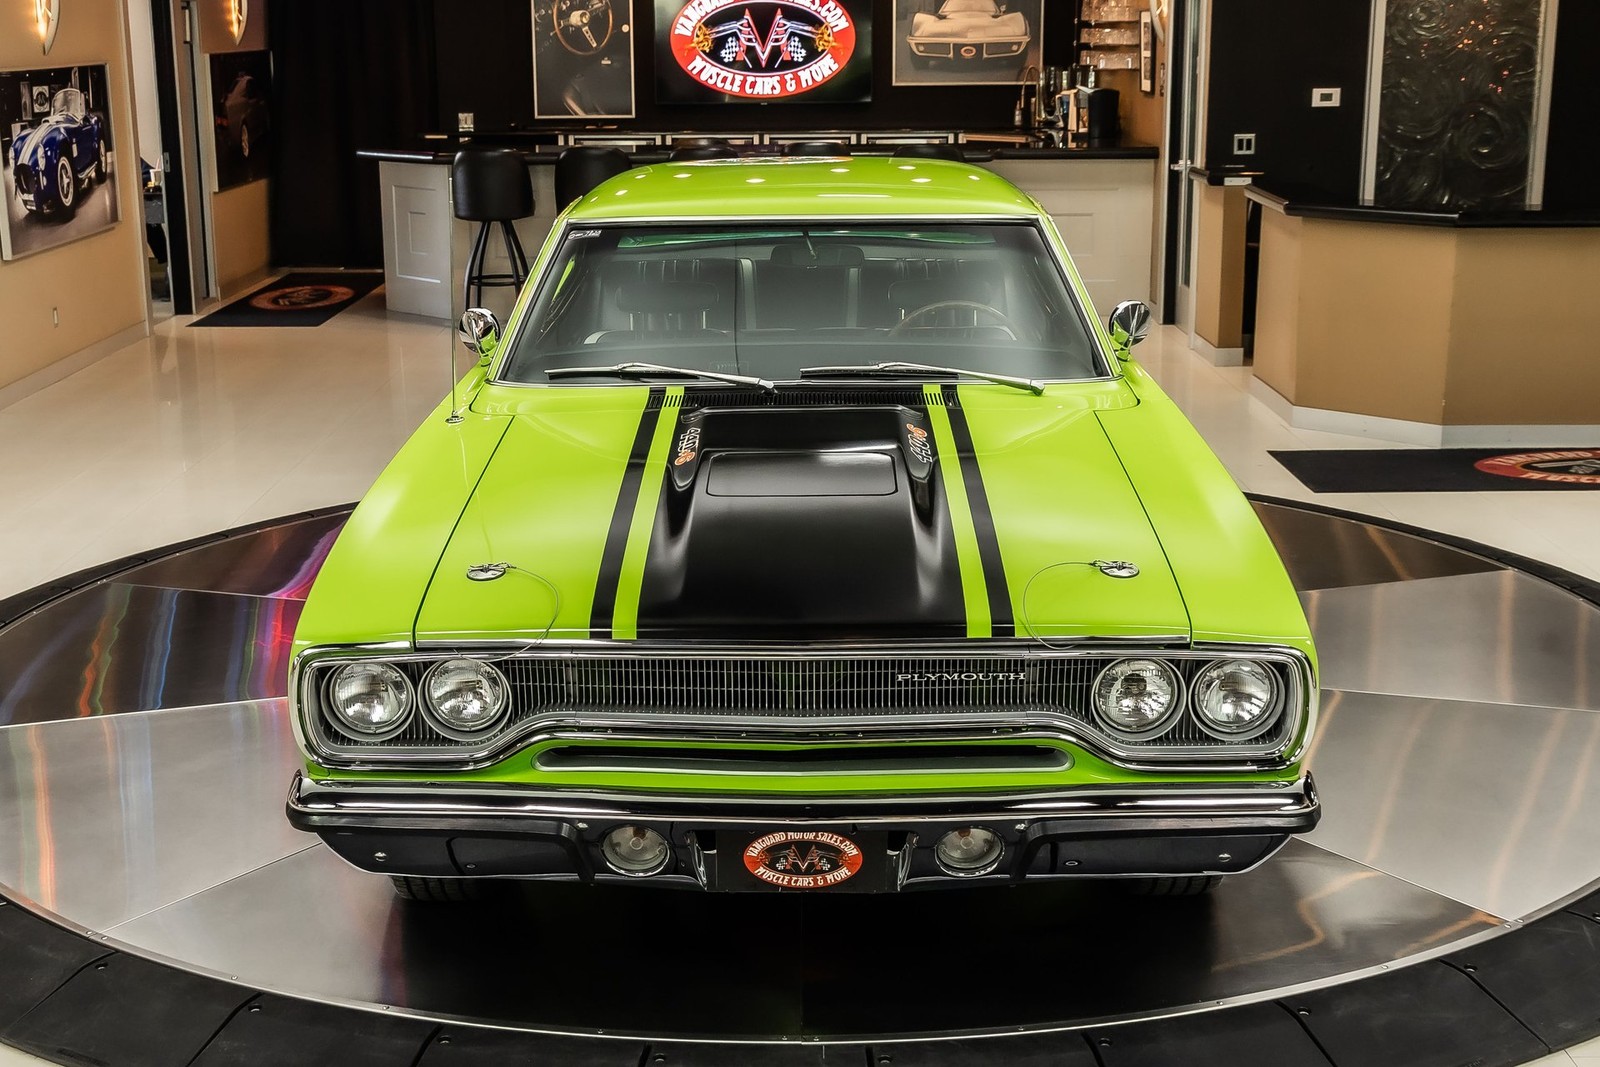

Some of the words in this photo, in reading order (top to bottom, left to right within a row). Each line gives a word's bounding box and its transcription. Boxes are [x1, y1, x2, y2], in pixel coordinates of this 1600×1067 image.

[686, 55, 743, 93] MUSCLE
[744, 75, 781, 95] CARS
[785, 73, 797, 92] &
[797, 53, 839, 88] MORE
[896, 672, 1026, 681] PLYMOUTH
[746, 831, 786, 857] VANGUARD
[816, 831, 859, 857] SALES.COM
[754, 866, 789, 885] MUSCLE
[790, 876, 814, 887] CARS
[817, 876, 824, 885] &
[825, 866, 852, 884] MORE
